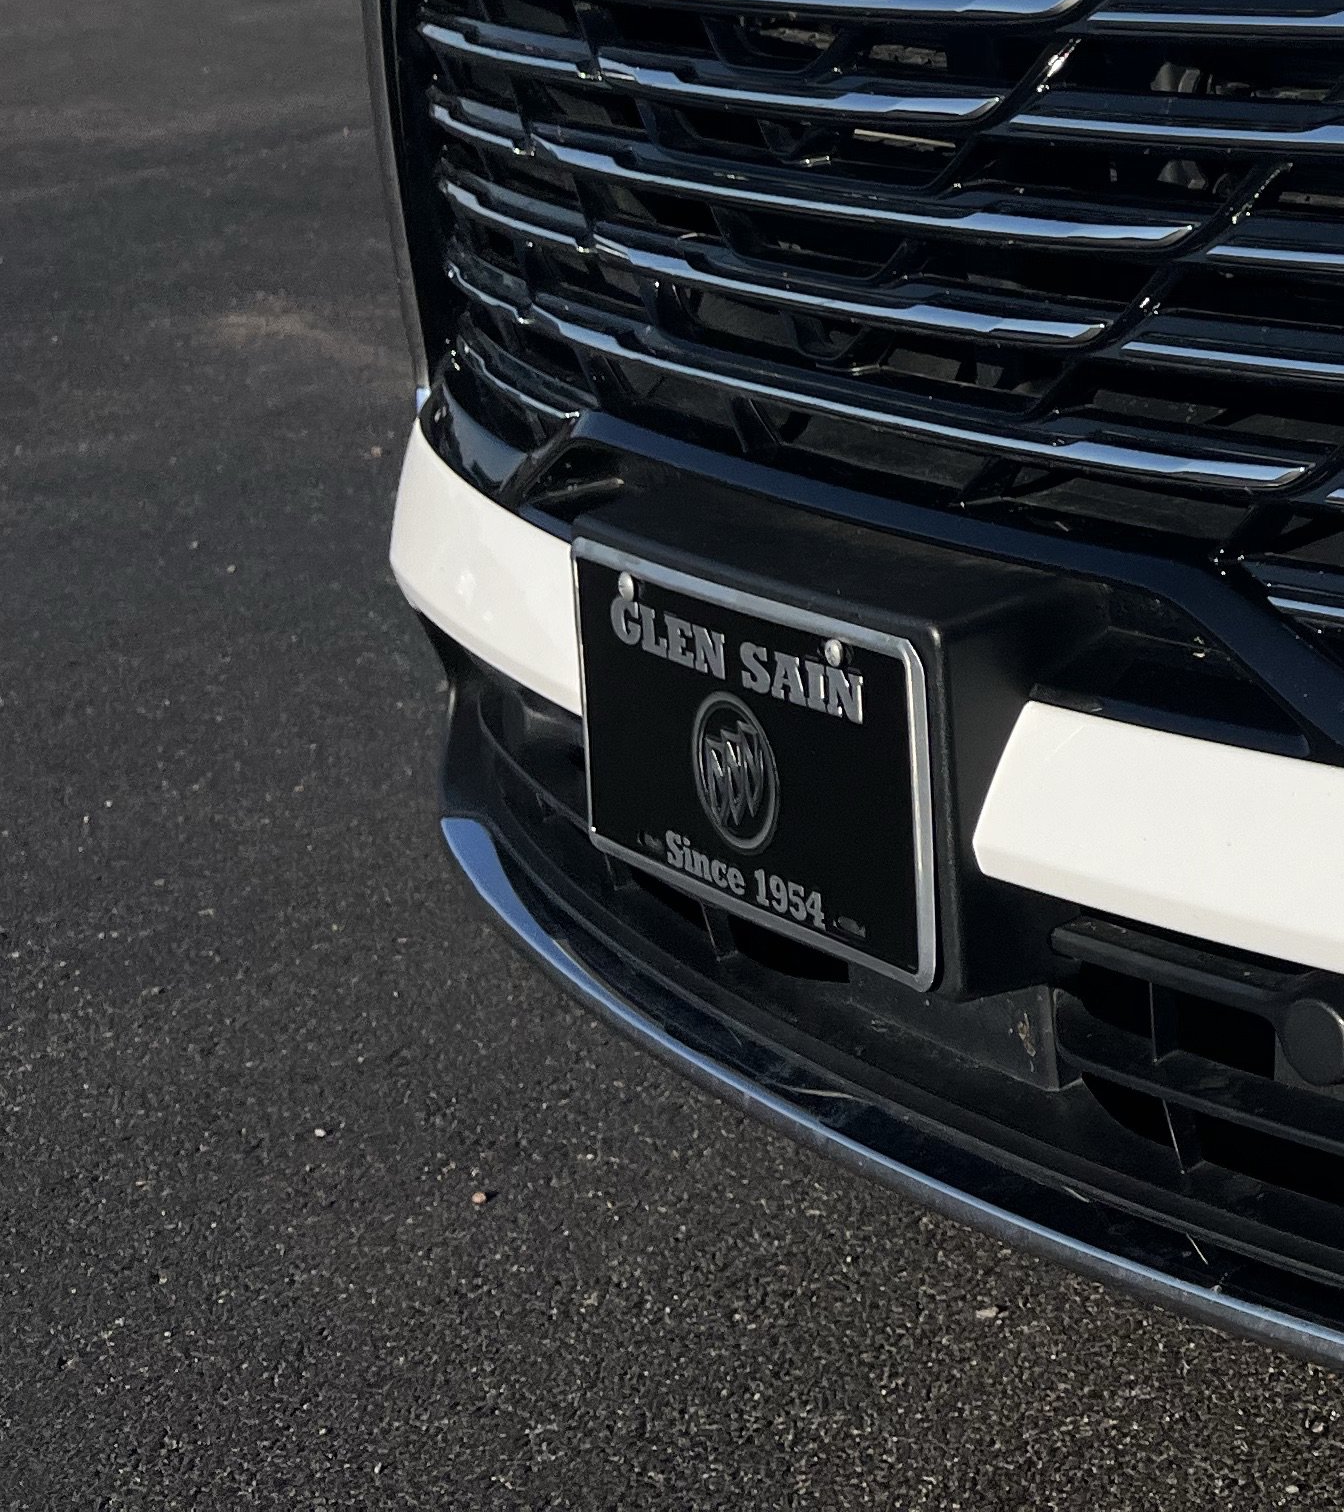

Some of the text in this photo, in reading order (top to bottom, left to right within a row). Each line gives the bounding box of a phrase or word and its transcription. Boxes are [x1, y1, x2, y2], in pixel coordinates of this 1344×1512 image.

[610, 594, 864, 726] GLEN SAIN
[665, 830, 827, 932] Since 1954
